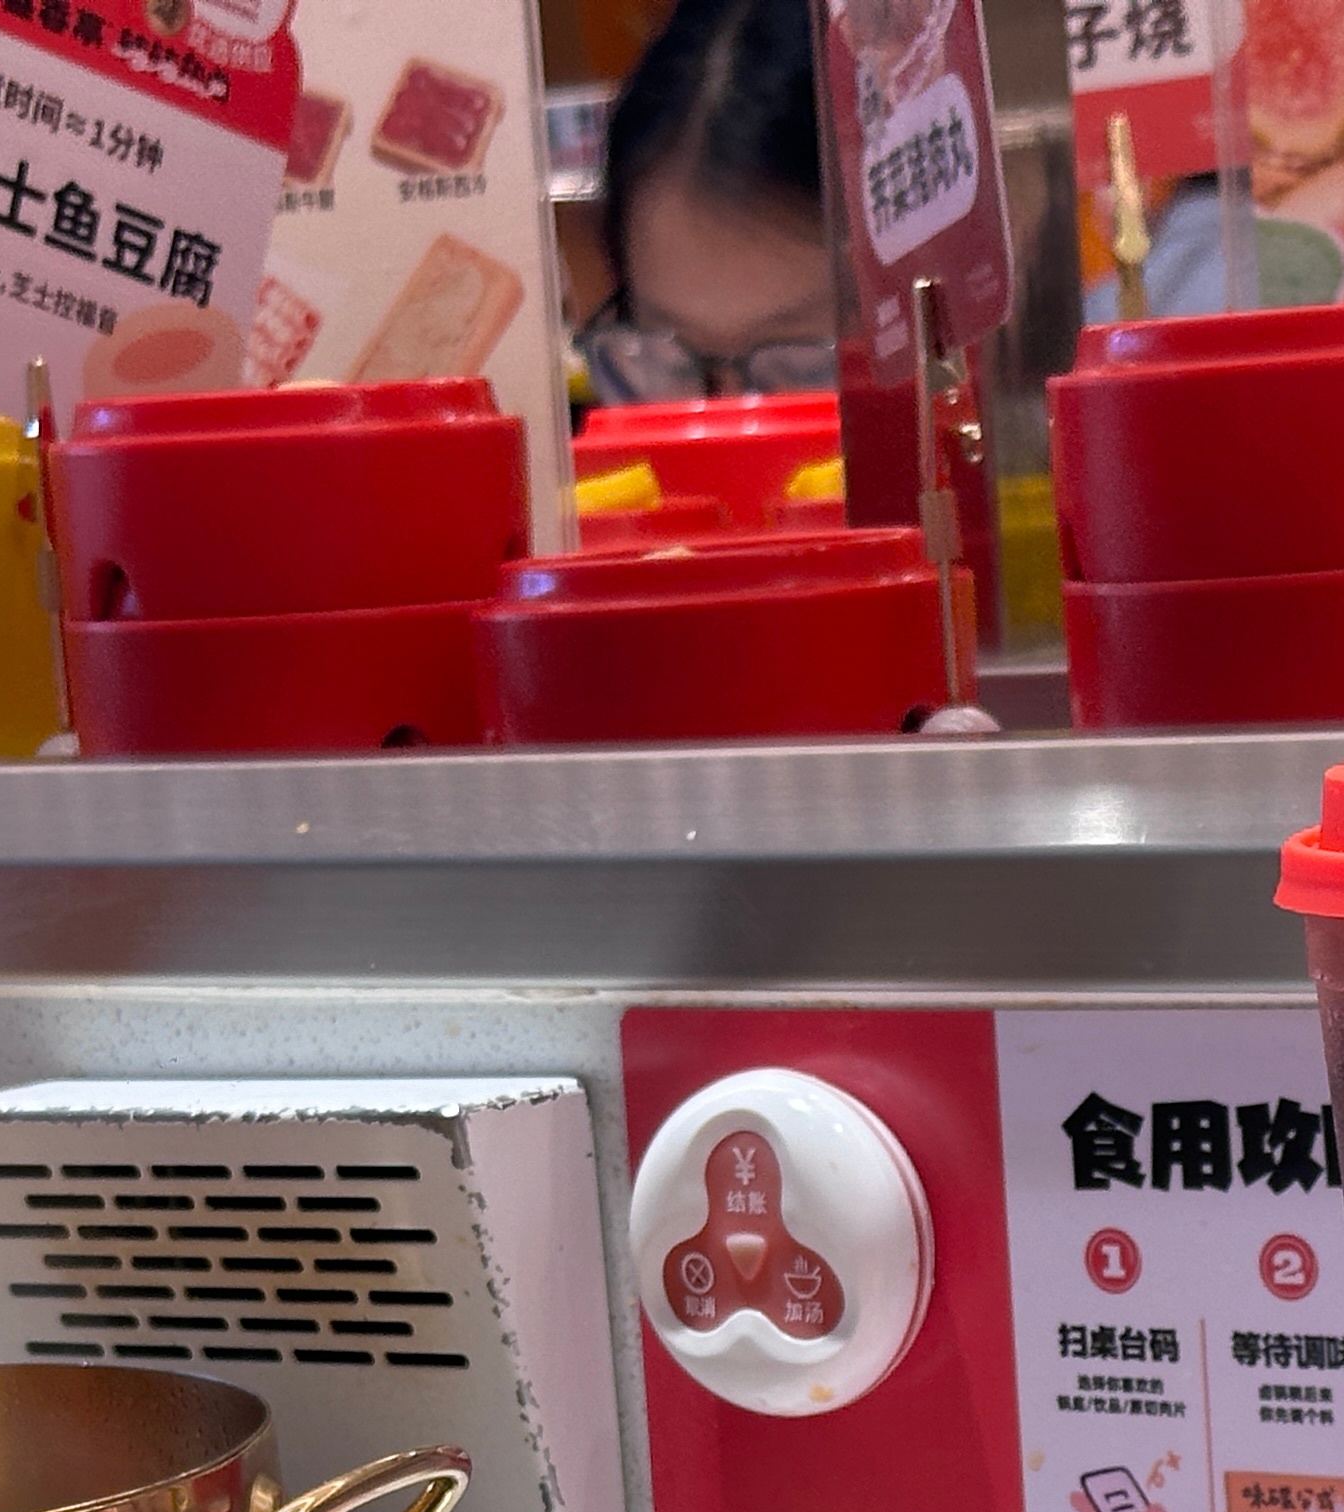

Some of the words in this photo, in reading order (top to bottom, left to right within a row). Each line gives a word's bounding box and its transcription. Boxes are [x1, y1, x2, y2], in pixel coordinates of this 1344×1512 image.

[1062, 1091, 1344, 1195] 食用攻
[726, 1191, 767, 1216] 结账
[1102, 1244, 1126, 1279] 1
[1271, 1249, 1305, 1285] 2
[785, 1300, 825, 1325] 加汤
[1058, 1323, 1181, 1364] 扫桌台码
